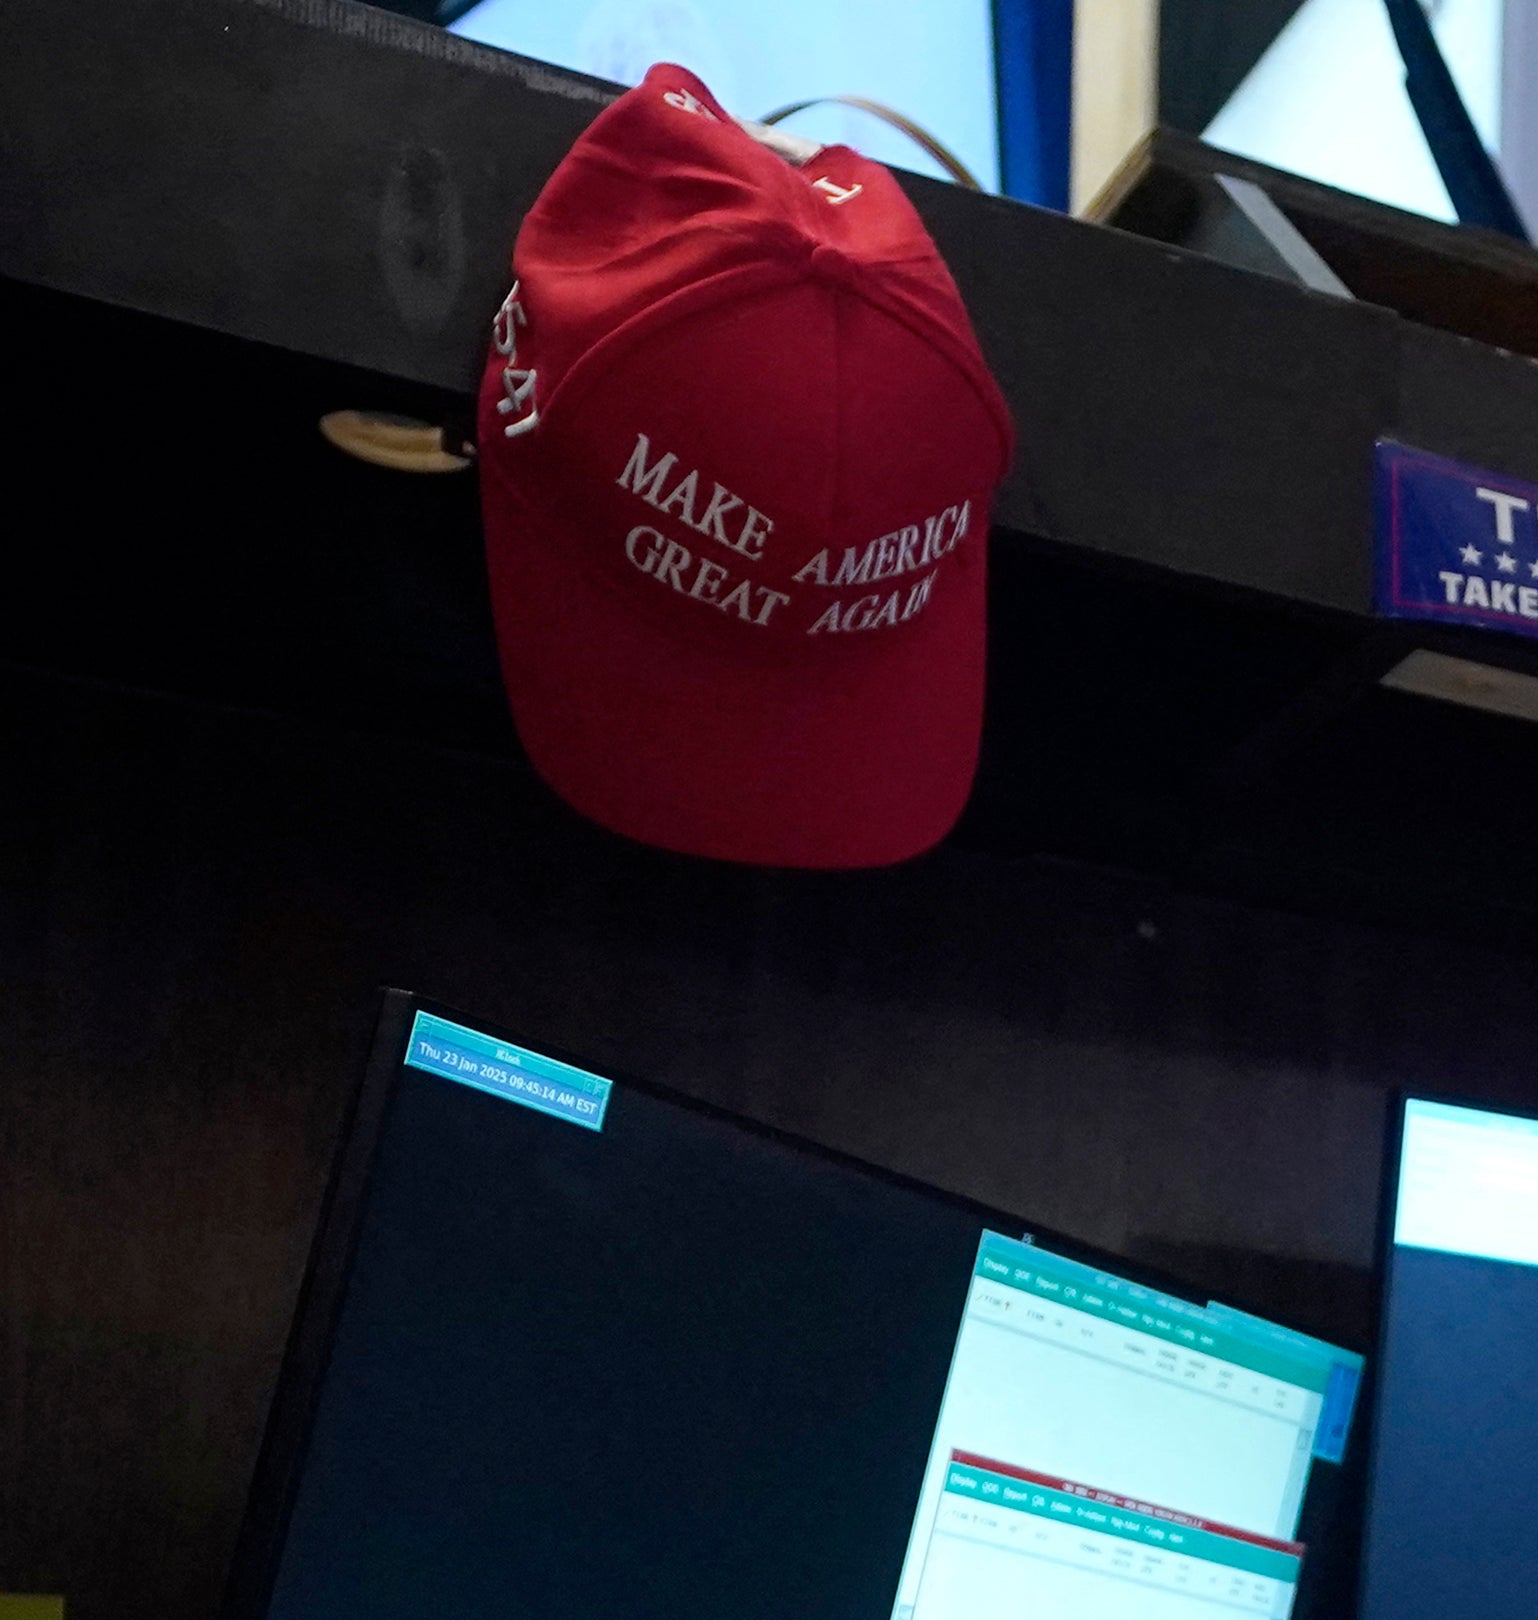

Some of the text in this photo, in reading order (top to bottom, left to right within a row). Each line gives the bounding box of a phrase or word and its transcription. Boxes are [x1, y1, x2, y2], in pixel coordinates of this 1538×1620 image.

[616, 433, 973, 587] MAKE AMERICA
[624, 526, 938, 637] GREAT AGAIN
[419, 1041, 598, 1115] Thu 23 Jan 2025 09:45:14 AM EST
